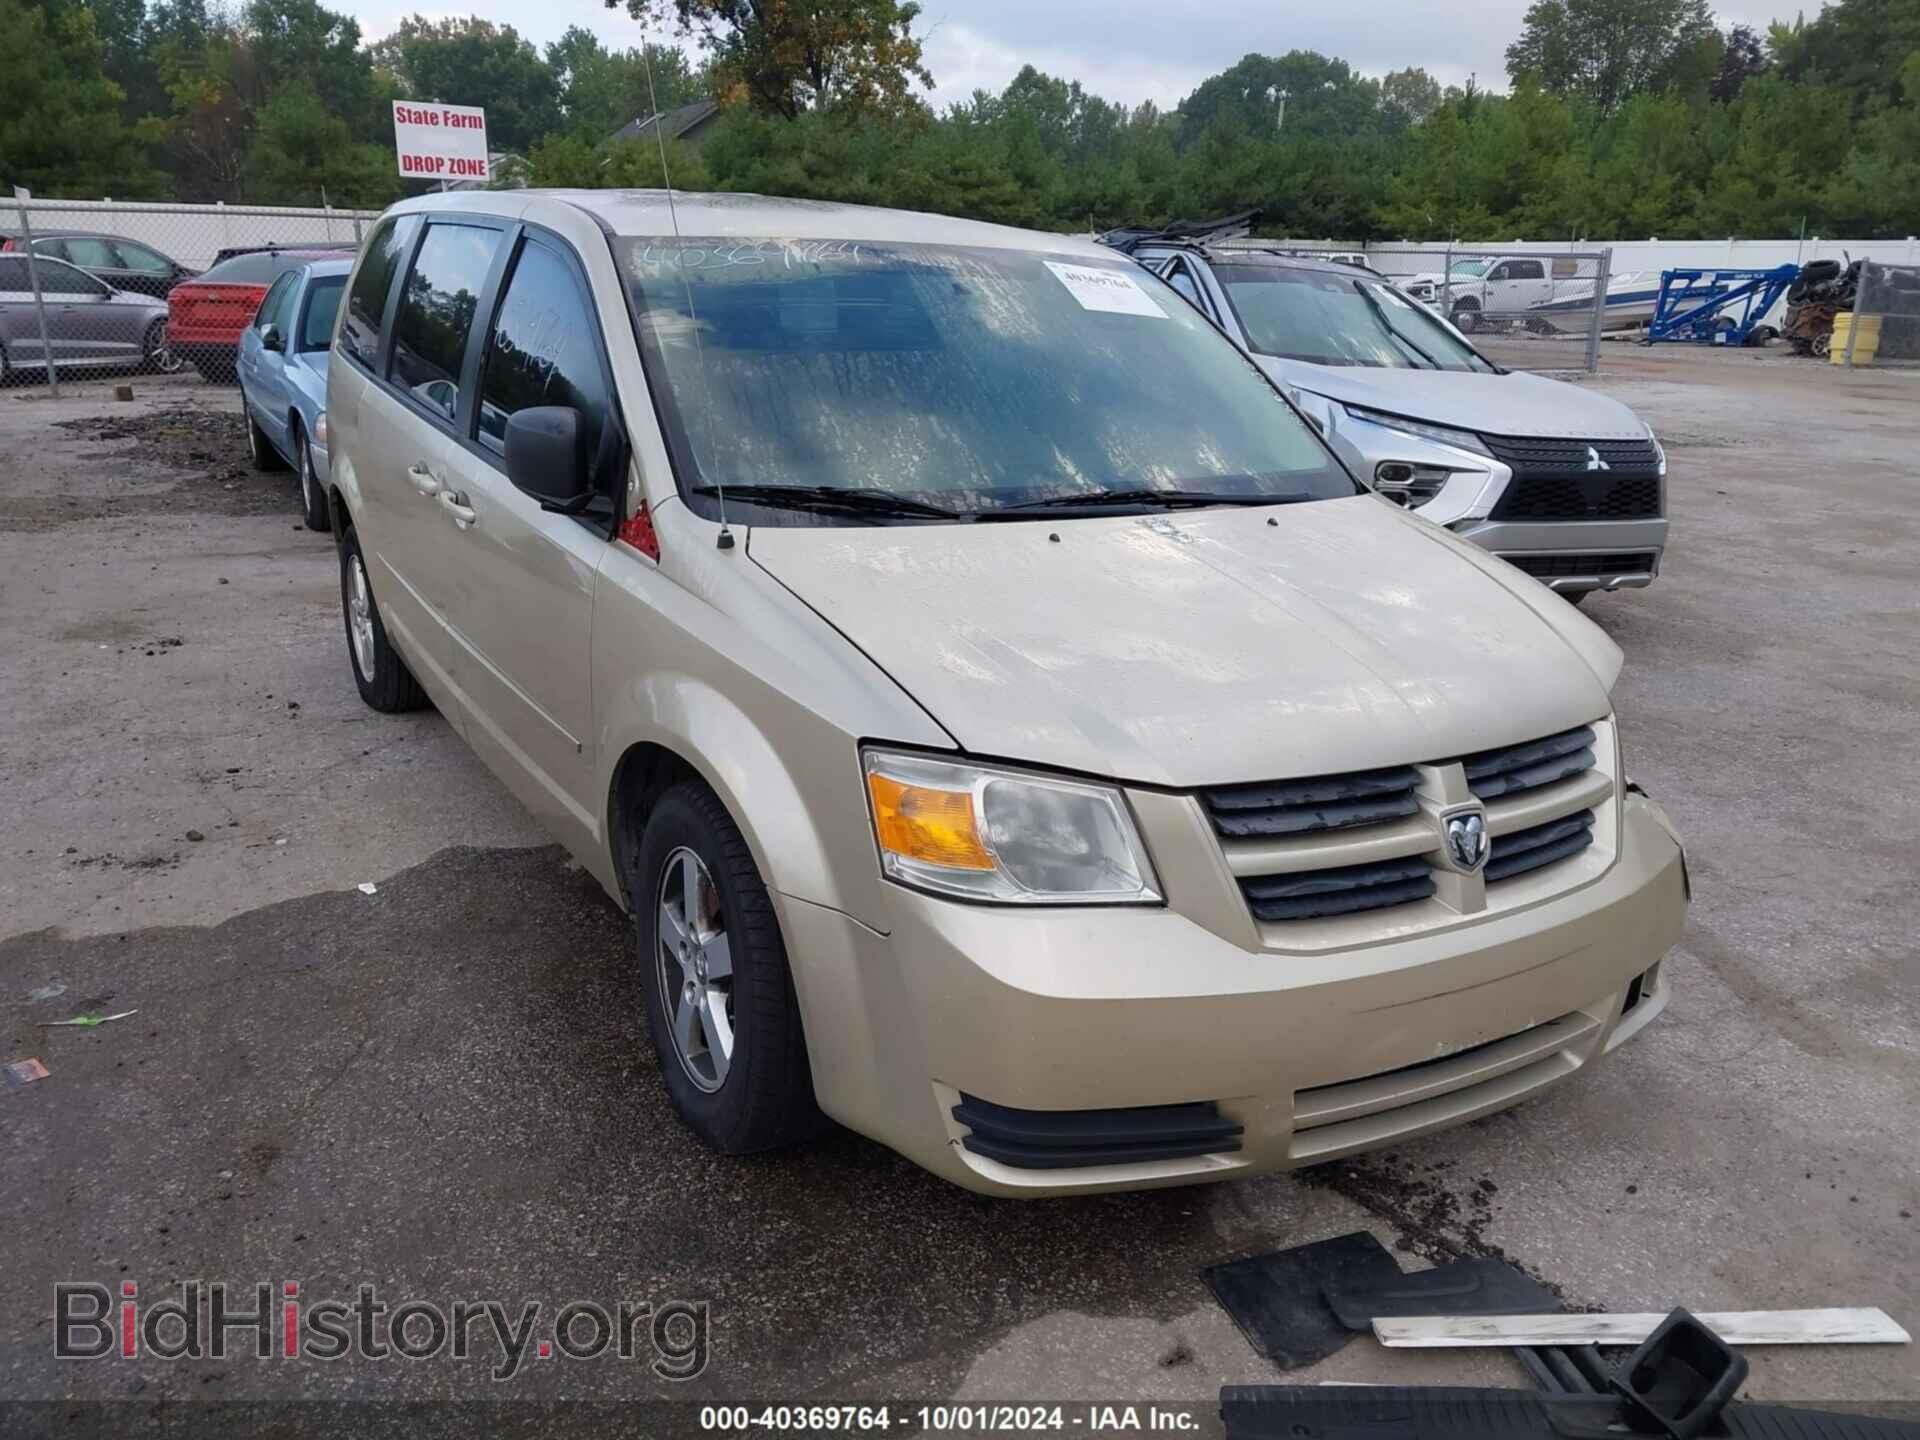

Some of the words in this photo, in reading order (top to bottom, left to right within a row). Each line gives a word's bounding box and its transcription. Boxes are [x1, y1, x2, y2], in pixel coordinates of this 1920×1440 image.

[396, 106, 440, 127] State
[443, 110, 483, 129] Farm
[402, 154, 445, 174] DROP
[448, 158, 486, 176] ZONE
